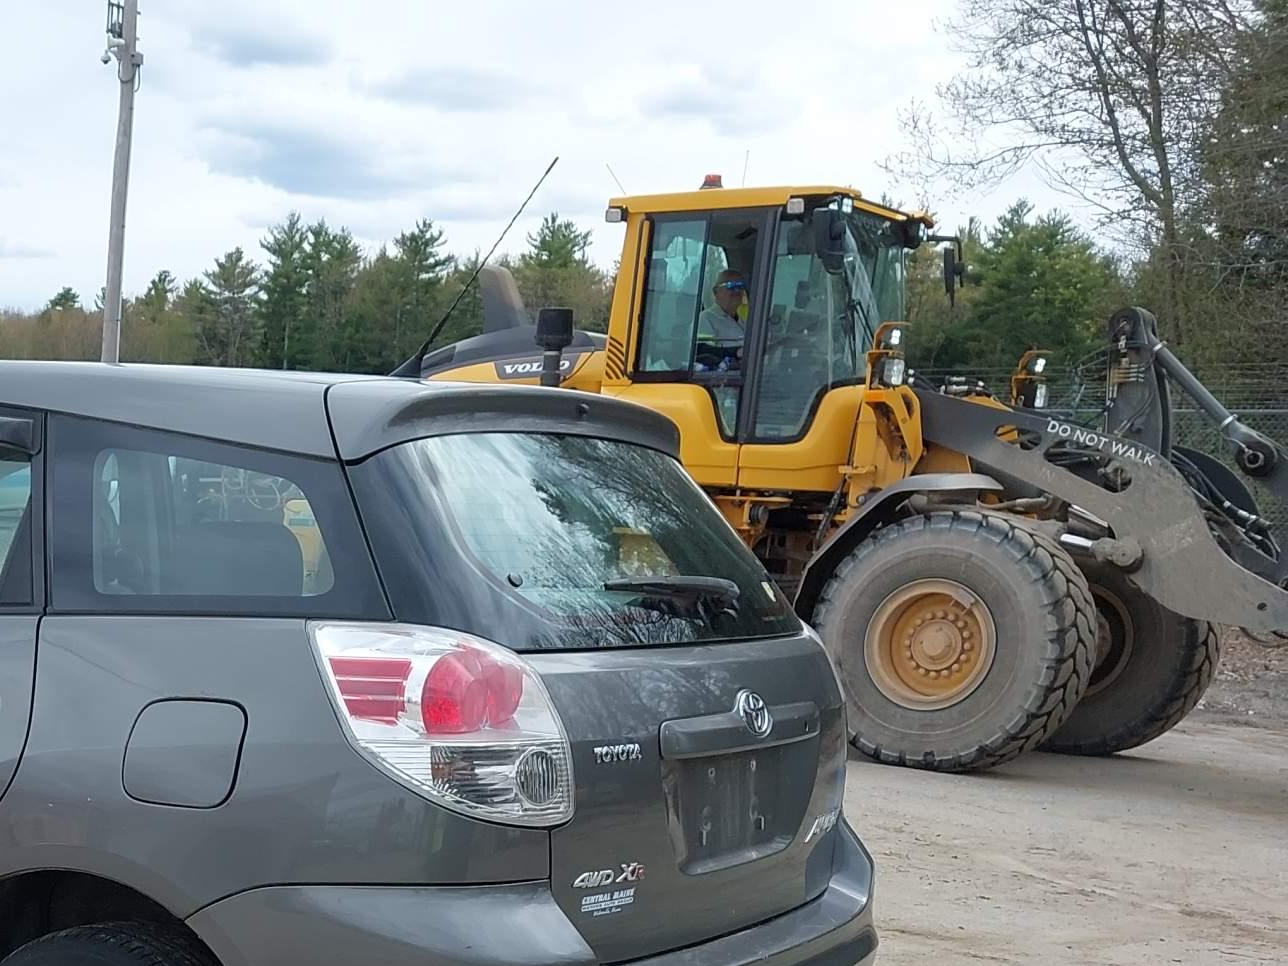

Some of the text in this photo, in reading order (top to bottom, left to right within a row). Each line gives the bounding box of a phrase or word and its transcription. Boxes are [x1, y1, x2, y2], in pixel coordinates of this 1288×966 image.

[504, 361, 570, 374] VOLO
[1046, 420, 1156, 467] DO NOT WALK
[593, 743, 642, 764] TOYOTA
[573, 869, 614, 889] 4WD
[581, 888, 637, 905] CENTRAL MAINE
